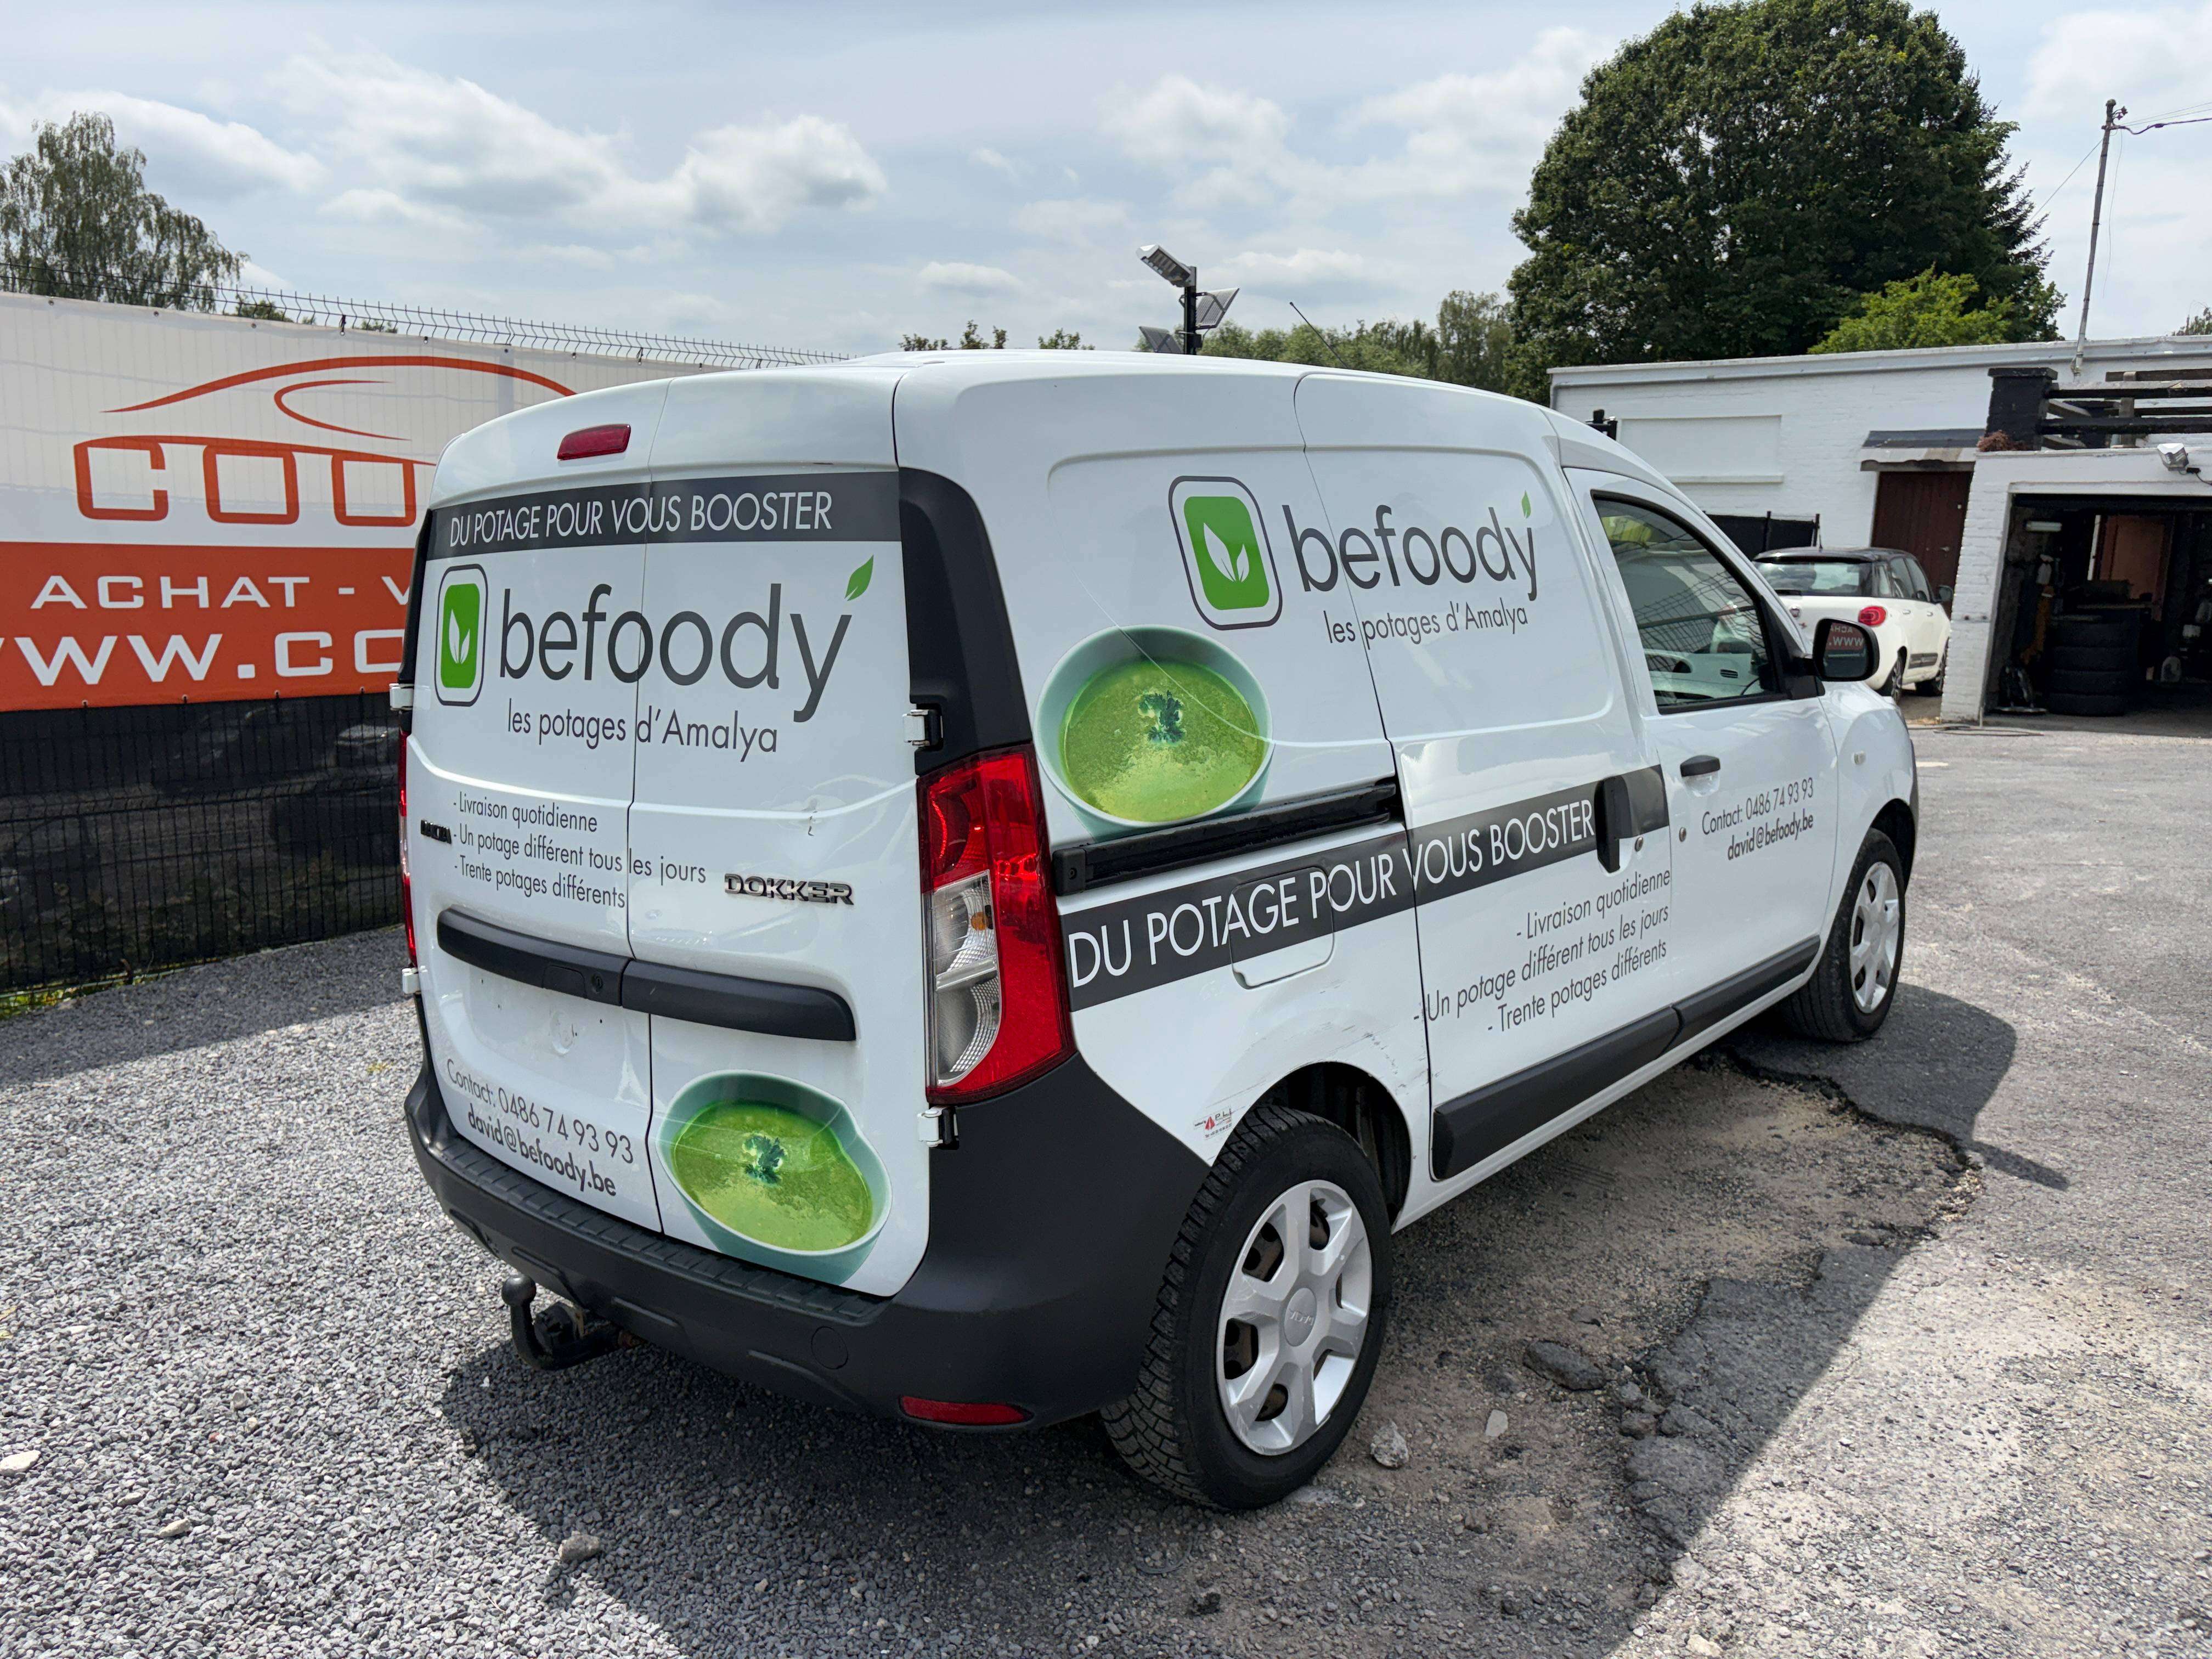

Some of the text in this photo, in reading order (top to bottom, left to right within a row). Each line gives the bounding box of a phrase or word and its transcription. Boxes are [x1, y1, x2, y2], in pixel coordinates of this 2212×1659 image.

[450, 492, 832, 547] DU POTAGE POUR VOUS BOOSTER
[1282, 504, 1537, 601] befoody
[30, 575, 310, 609] ACHAT
[500, 583, 852, 723] befoody
[1323, 610, 1356, 644] les
[1362, 612, 1441, 650] potages
[508, 698, 531, 733] les
[539, 709, 626, 749] potages
[460, 791, 507, 820] Livraison
[512, 802, 597, 833] quotidienne
[1702, 777, 1813, 835] Contact: 0486 74 93 93
[1728, 808, 1814, 861] david@befoody.be
[460, 823, 473, 846] Un
[478, 833, 520, 860] potage
[524, 833, 584, 866] différent
[589, 848, 623, 871] tous
[629, 848, 652, 877] les
[660, 856, 707, 885] jours
[460, 855, 492, 882] Trente
[496, 869, 547, 898] potages
[553, 872, 625, 909] différents
[724, 873, 854, 906] DOKKER
[1069, 799, 1595, 988] DU POTAGE POUR VOUS BOOSTER
[1527, 900, 1590, 940] Livraison
[1596, 870, 1671, 919] quotidienne
[1427, 990, 1450, 1022] Un
[1457, 969, 1515, 1018] potage
[1521, 936, 1584, 981] différent
[1588, 929, 1614, 955] tous
[1619, 914, 1635, 941] les
[1640, 905, 1669, 939] jours
[1498, 995, 1545, 1032] Trente
[1551, 969, 1607, 1018] potages
[1611, 939, 1667, 981] différents
[447, 1059, 633, 1164] Contact: 0486 74 93 93
[468, 1103, 616, 1197] david@befoody.be
